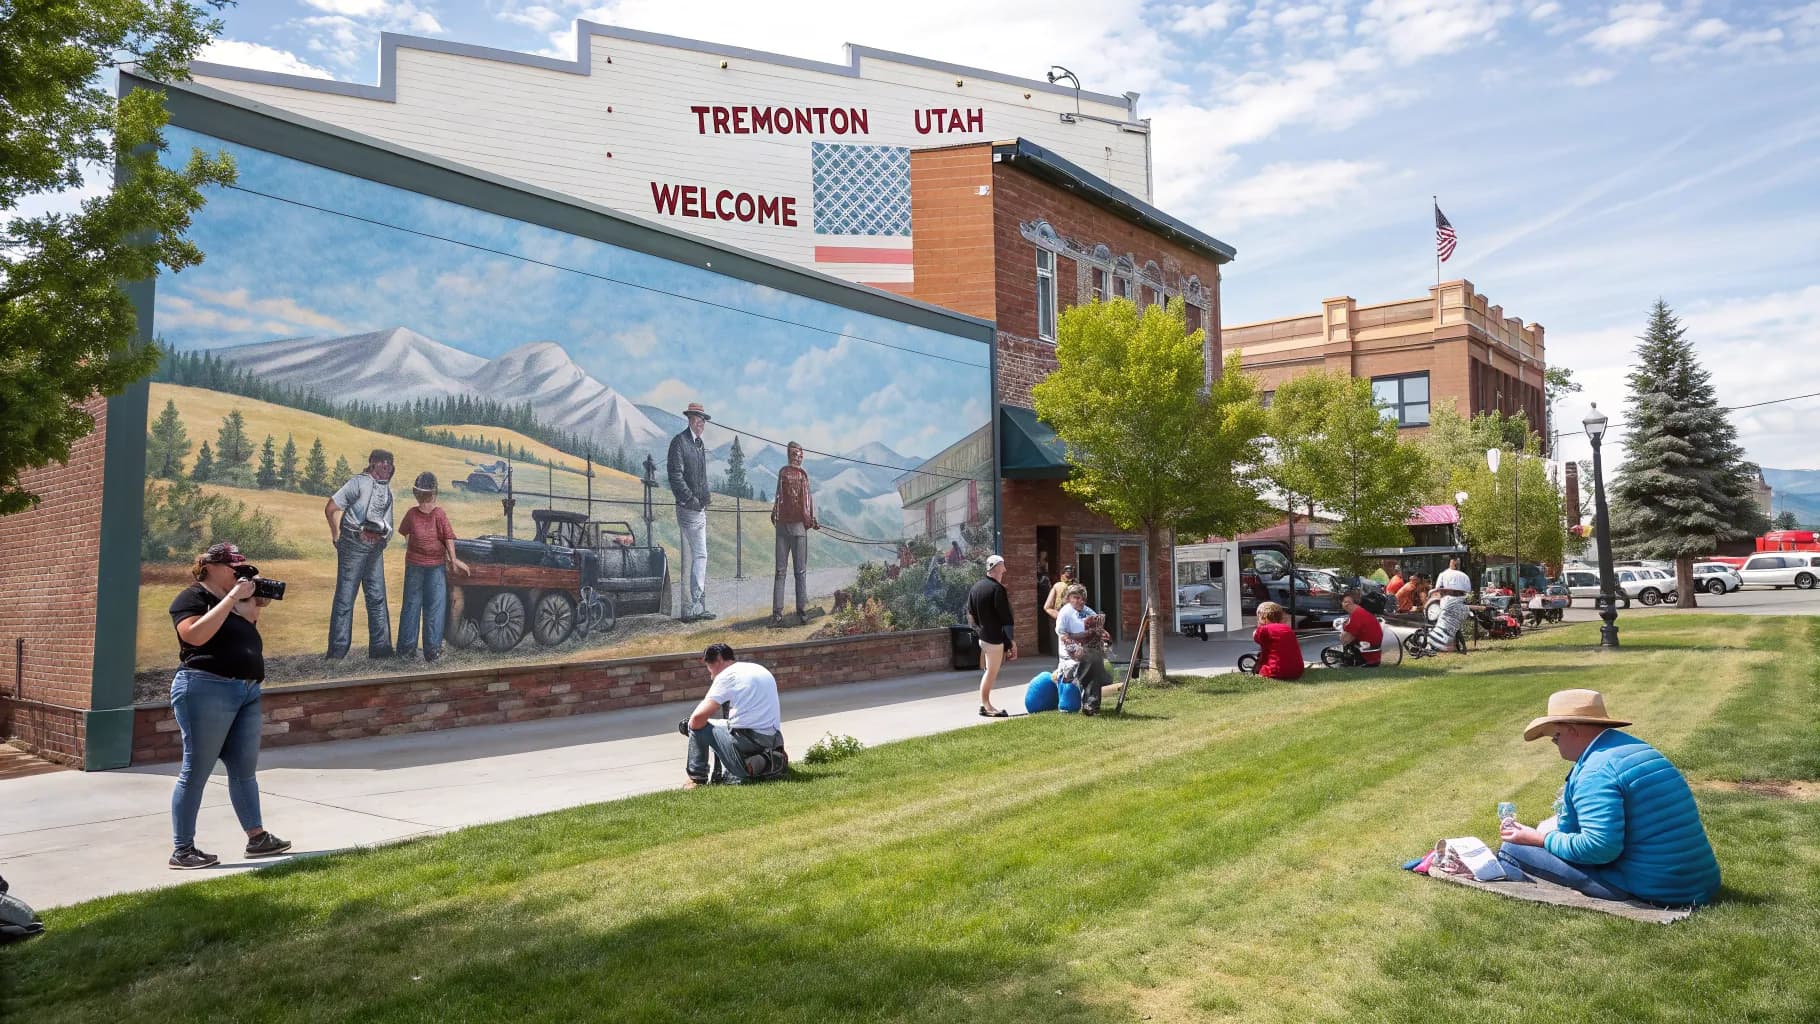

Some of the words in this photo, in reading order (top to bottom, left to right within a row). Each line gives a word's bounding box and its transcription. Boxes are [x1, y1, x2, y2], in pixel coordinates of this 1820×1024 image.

[691, 105, 869, 135] TREMONTON
[914, 107, 985, 134] UTAH
[650, 181, 798, 227] WELCOME
